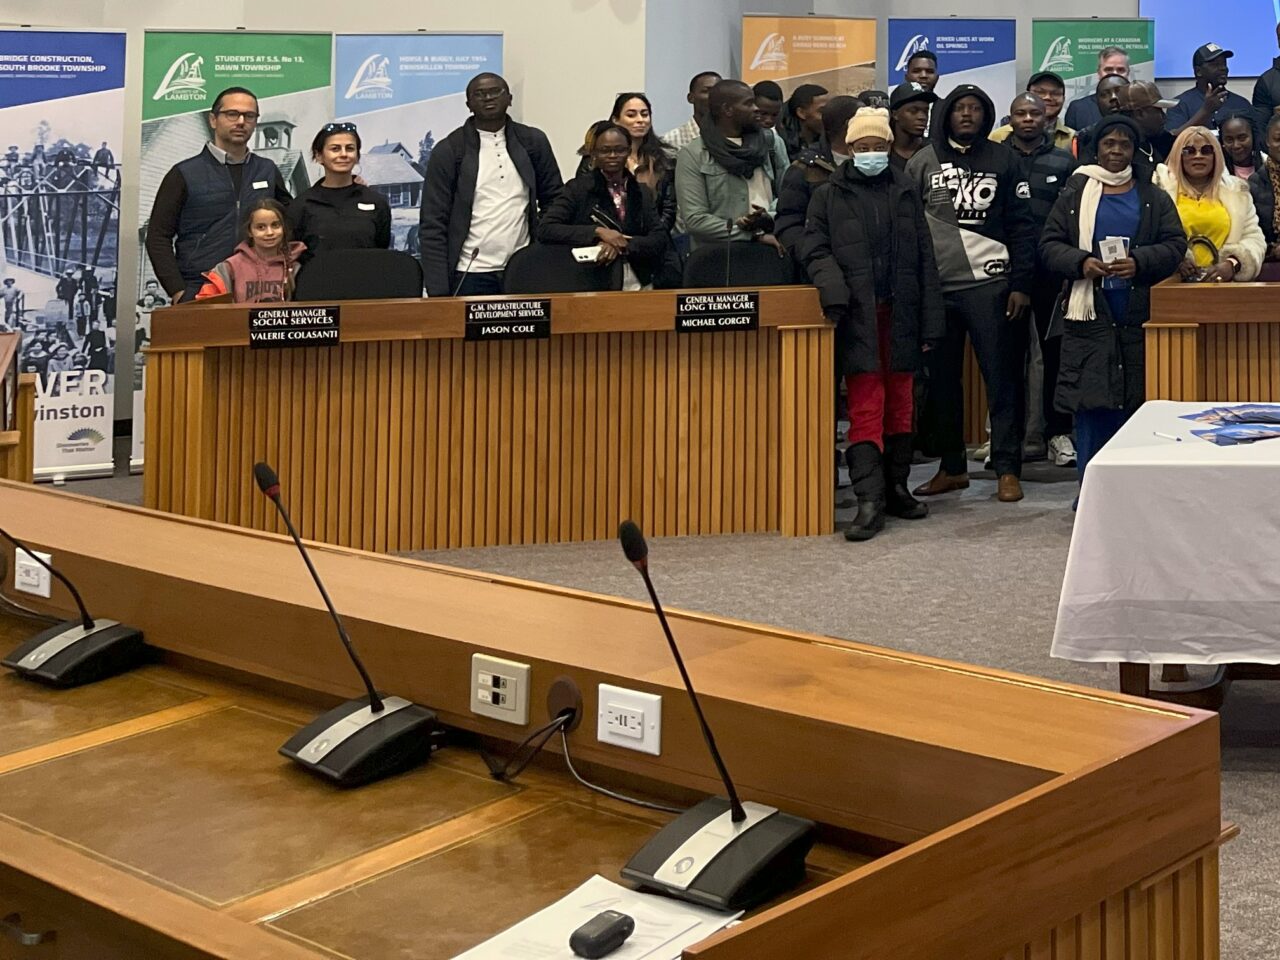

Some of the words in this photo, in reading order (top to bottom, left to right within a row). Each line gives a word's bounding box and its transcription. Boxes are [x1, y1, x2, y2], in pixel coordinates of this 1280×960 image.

[29, 55, 94, 63] CONSTRUCTION,
[685, 295, 714, 304] GENERAL
[716, 294, 749, 302] MANAGER
[471, 303, 485, 311] G.M.
[487, 301, 542, 310] INFRASTRUCTURE
[680, 303, 706, 311] LONG
[708, 302, 731, 310] TERM
[732, 301, 755, 309] CARE
[257, 310, 289, 318] GENERAL
[291, 308, 327, 317] MANAGER
[475, 310, 517, 319] DEVELOPMENT
[518, 308, 545, 317] SERVICES
[253, 318, 288, 327] SOCIAL
[290, 316, 334, 326] SERVICES
[682, 318, 716, 326] MICHAEL
[718, 316, 751, 326] GORGEY
[250, 331, 285, 340] VALERIE
[287, 329, 338, 339] COLASANTI
[481, 325, 510, 335] JASON
[512, 324, 535, 333] COLE
[35, 369, 107, 398] VER
